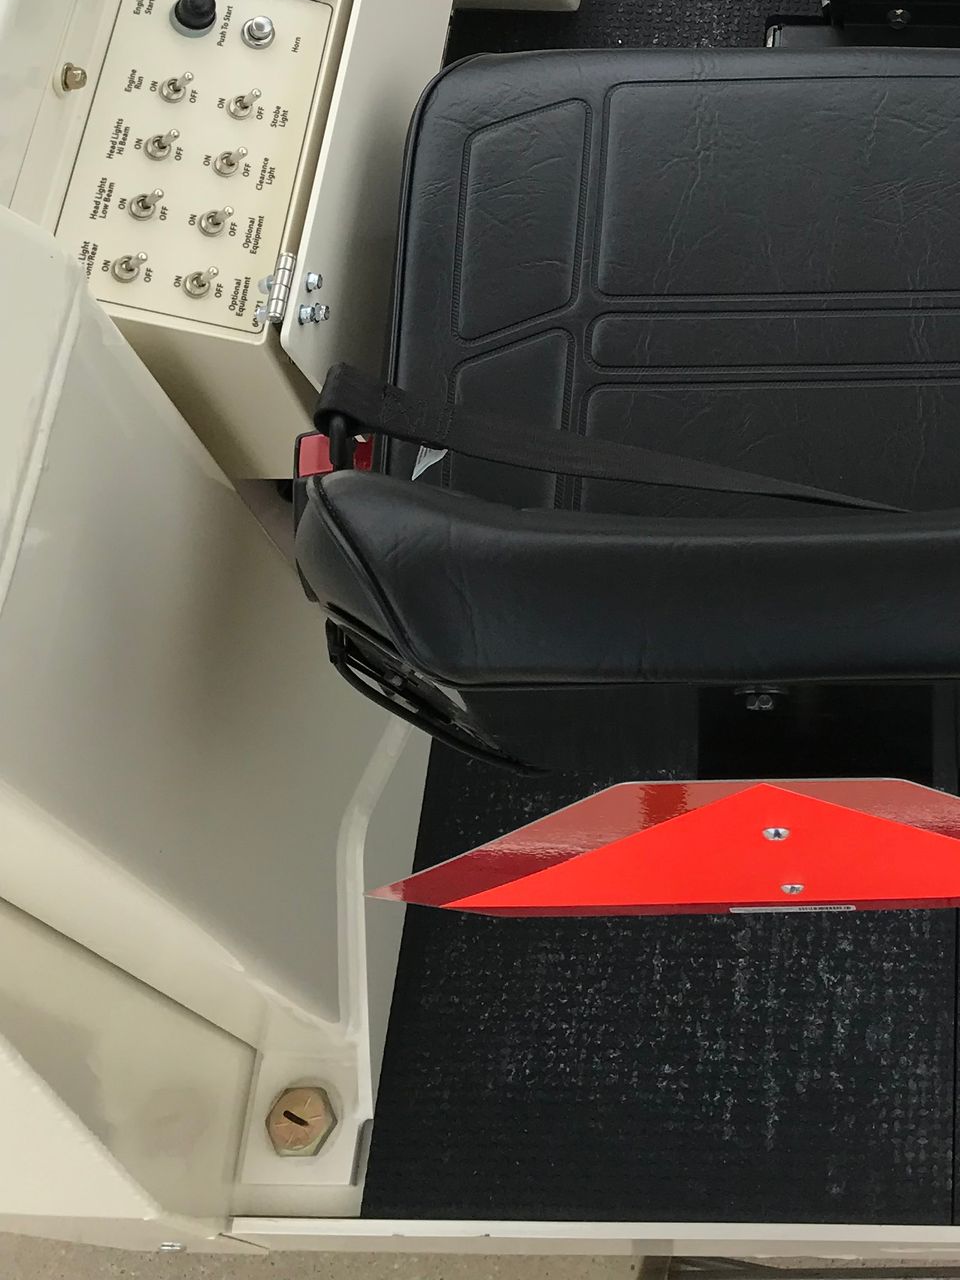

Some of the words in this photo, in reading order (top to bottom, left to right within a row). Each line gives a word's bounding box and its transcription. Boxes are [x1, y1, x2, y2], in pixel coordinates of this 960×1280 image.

[223, 5, 233, 22] Start
[221, 20, 229, 30] To
[217, 28, 227, 47] Push
[291, 36, 301, 53] Horn
[124, 69, 137, 93] Engine
[134, 76, 144, 90] Run
[149, 80, 159, 92] ON
[189, 89, 198, 104] OFF
[217, 97, 226, 109] ON
[256, 106, 265, 120] OFF
[270, 105, 282, 128] Strobe
[278, 110, 289, 128] Light
[111, 118, 124, 140] Lights
[119, 126, 130, 146] Beam
[106, 139, 118, 160] Head
[116, 145, 125, 156] Hi
[134, 138, 143, 150] ON
[174, 146, 184, 162] OFF
[202, 154, 212, 167] ON
[242, 163, 252, 178] OFF
[255, 157, 270, 191] Clearance
[265, 166, 276, 185] Light
[89, 199, 101, 220] Head
[95, 177, 108, 200] Lights
[98, 202, 110, 219] Low
[106, 182, 116, 203] Beam
[118, 197, 127, 210] ON
[159, 205, 169, 221] OFF
[188, 214, 197, 226] ON
[228, 222, 238, 237] OFF
[242, 217, 256, 249] Optional
[249, 215, 265, 255] Equipment
[78, 241, 90, 261] Light
[101, 259, 111, 272] ON
[143, 267, 154, 283] OFF
[173, 275, 183, 288] ON
[214, 283, 224, 299] OFF
[228, 278, 242, 311] Optional
[235, 276, 251, 317] Equipment
